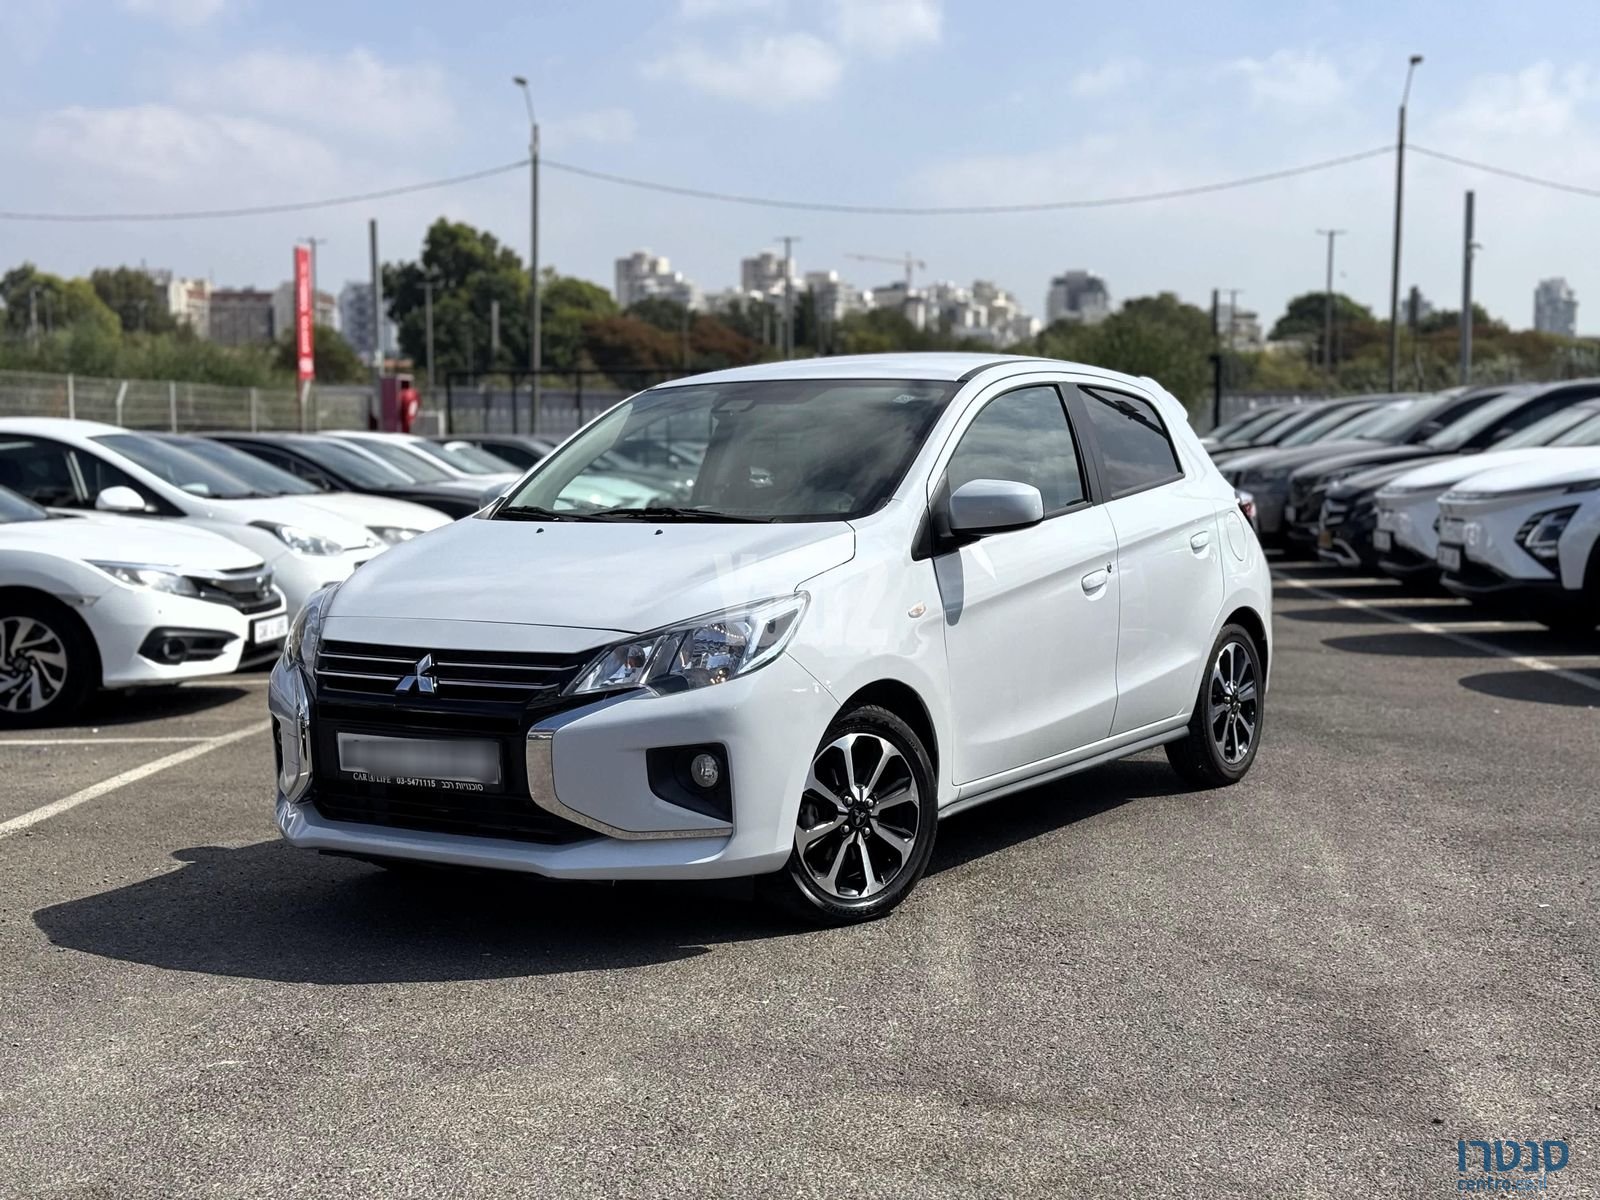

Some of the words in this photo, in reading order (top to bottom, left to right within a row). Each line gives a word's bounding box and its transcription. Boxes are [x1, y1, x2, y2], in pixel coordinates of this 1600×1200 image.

[353, 772, 367, 781] CAR
[376, 775, 391, 783] LIFE
[396, 777, 436, 788] 03-5471115
[441, 780, 455, 789] רכב
[456, 782, 484, 791] סוכנויות
